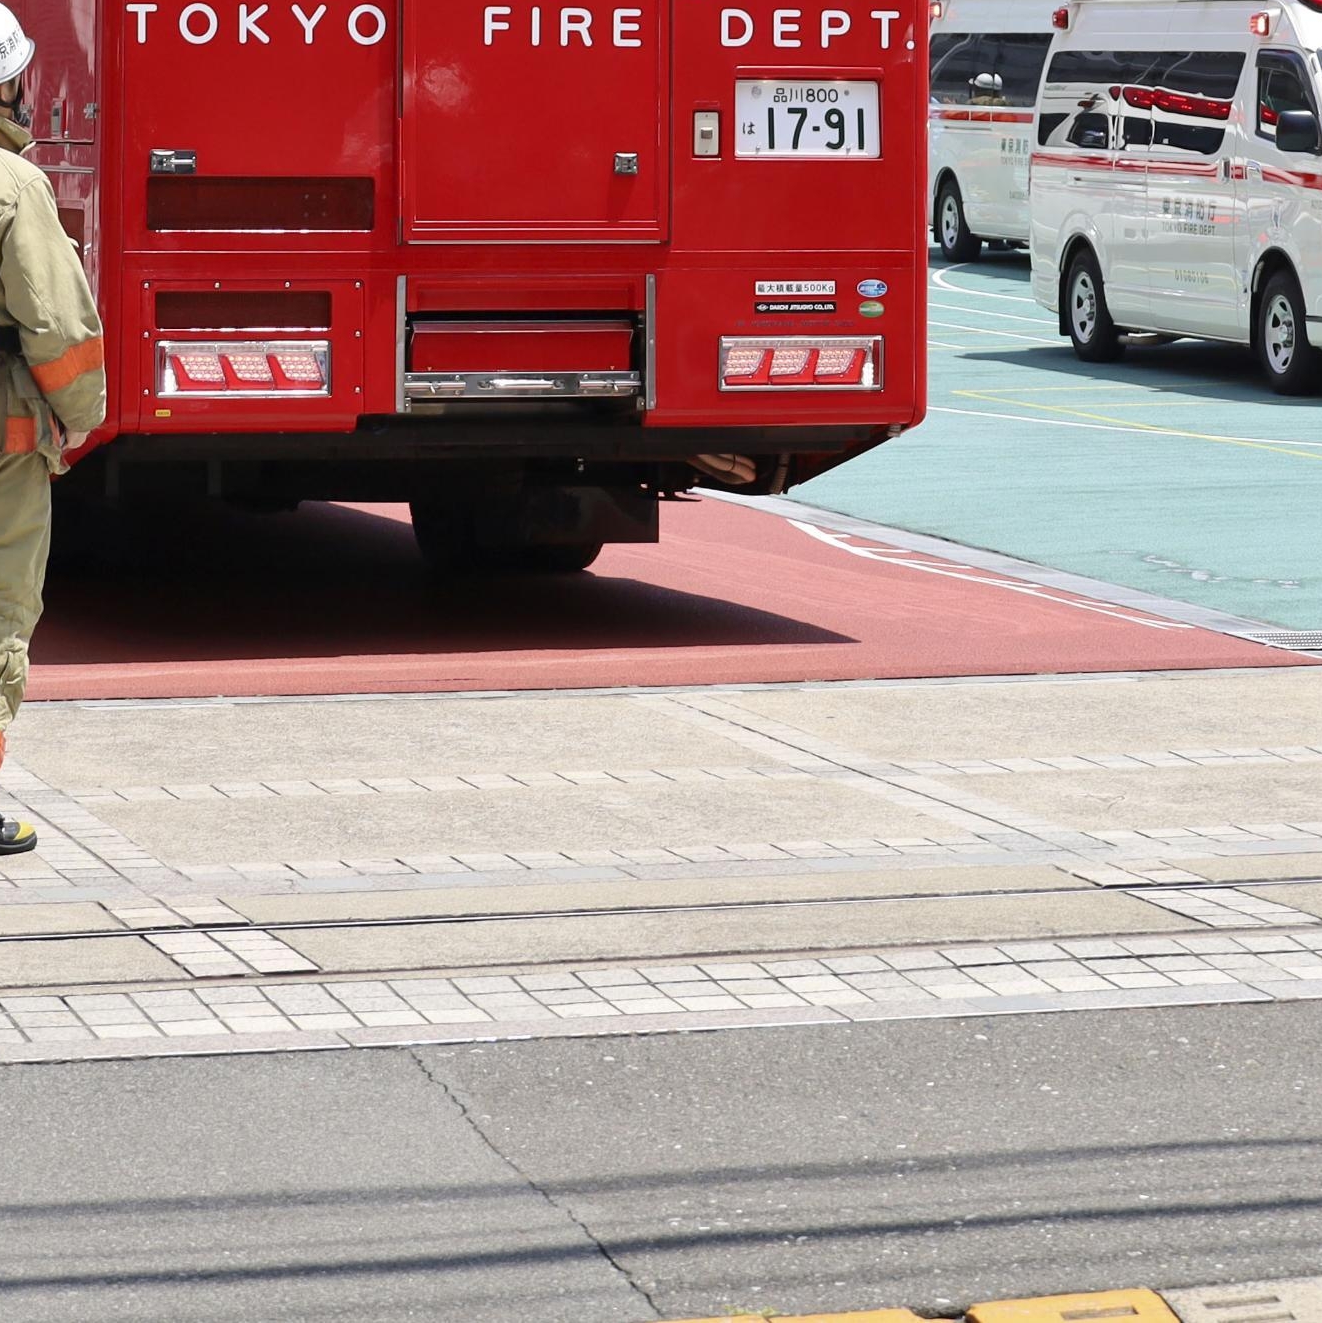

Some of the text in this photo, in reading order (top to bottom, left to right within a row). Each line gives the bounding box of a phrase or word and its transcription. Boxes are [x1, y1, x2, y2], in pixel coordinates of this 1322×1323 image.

[126, 2, 915, 51] TOKYO FIRE DEPT.
[742, 107, 865, 150] は 17-91
[1183, 223, 1198, 234] FIRE
